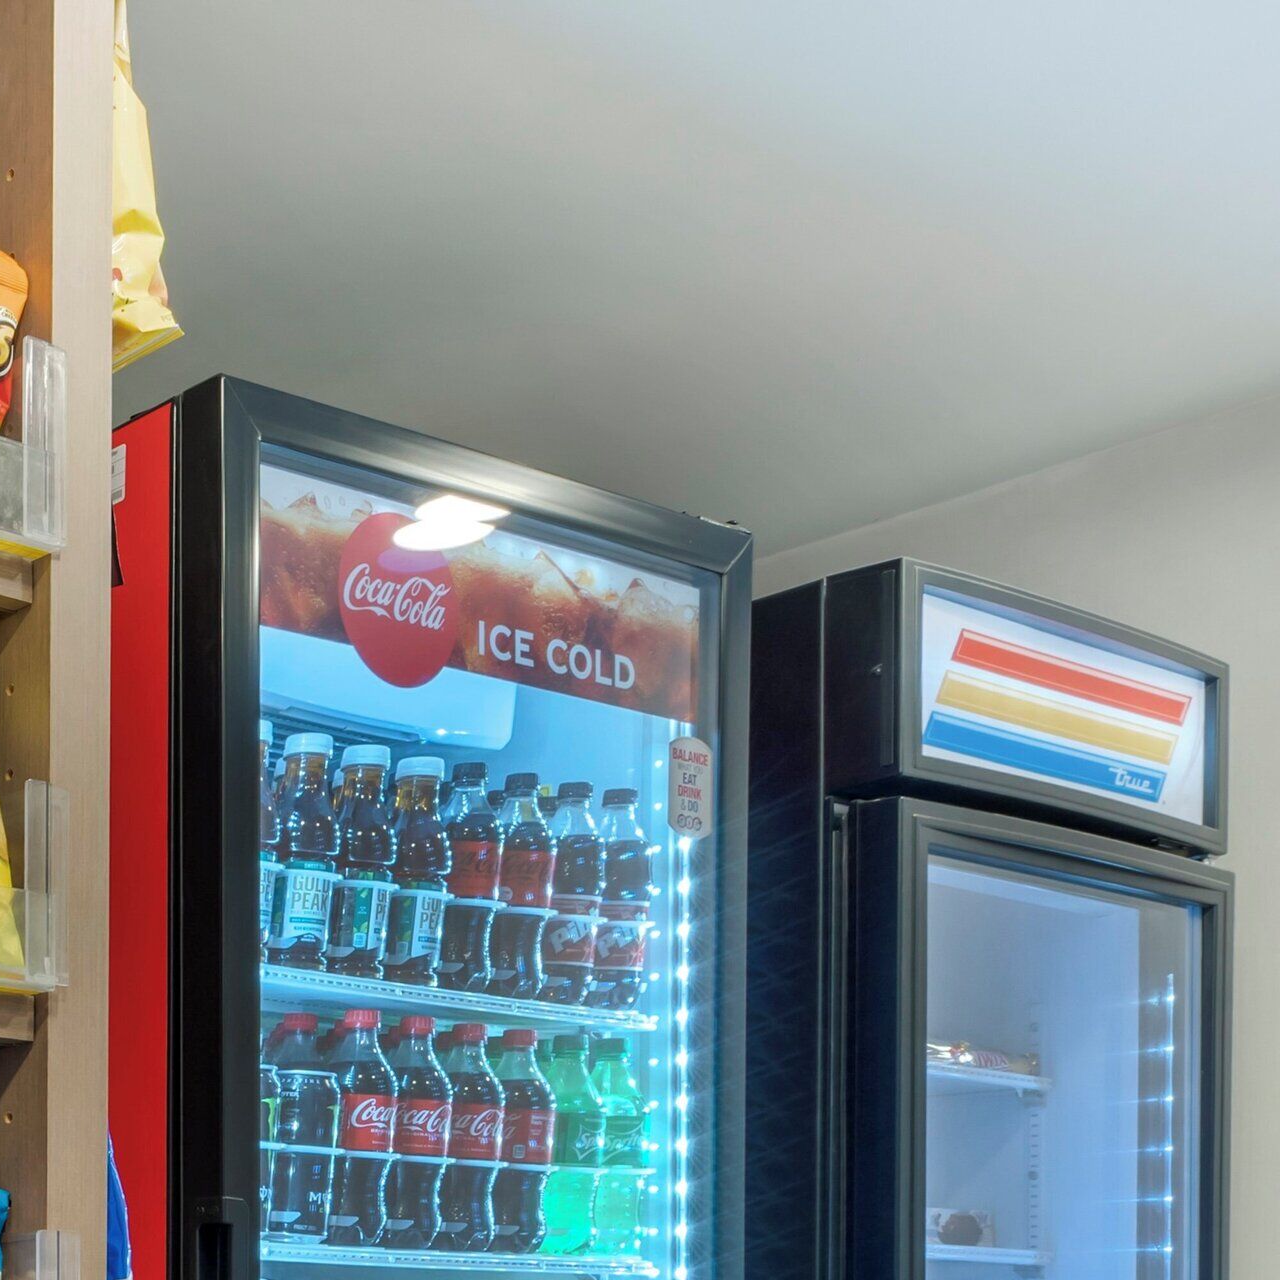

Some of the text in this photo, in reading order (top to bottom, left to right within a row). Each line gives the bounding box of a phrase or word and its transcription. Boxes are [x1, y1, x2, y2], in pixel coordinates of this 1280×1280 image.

[342, 561, 452, 632] Coca-Cola
[477, 619, 638, 691] ICE COLD
[671, 747, 709, 767] BALANCE
[681, 772, 698, 786] EAT
[1108, 764, 1154, 795] true
[677, 785, 703, 801] DRINK
[290, 892, 328, 913] PEAK
